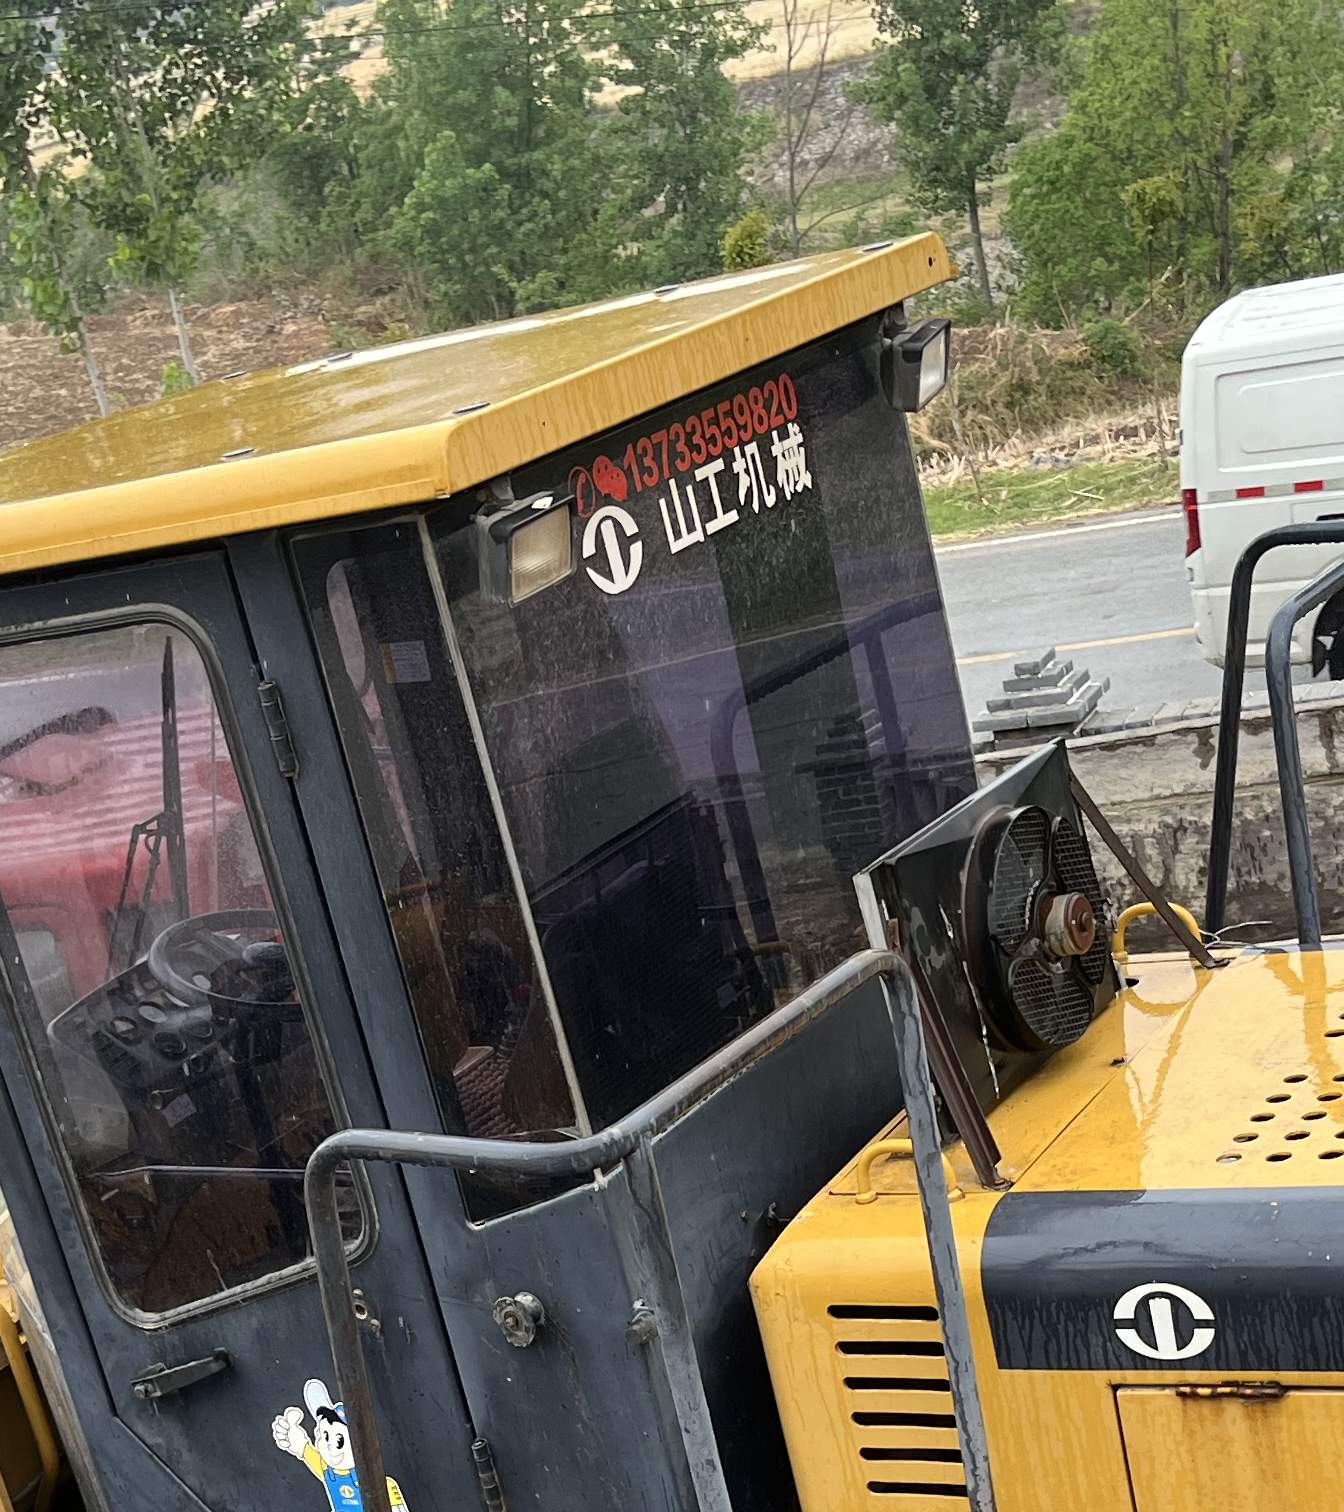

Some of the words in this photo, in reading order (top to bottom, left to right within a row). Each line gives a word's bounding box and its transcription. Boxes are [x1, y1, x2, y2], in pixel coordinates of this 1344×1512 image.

[623, 373, 799, 493] 13733559820
[658, 421, 813, 555] 山工机械
